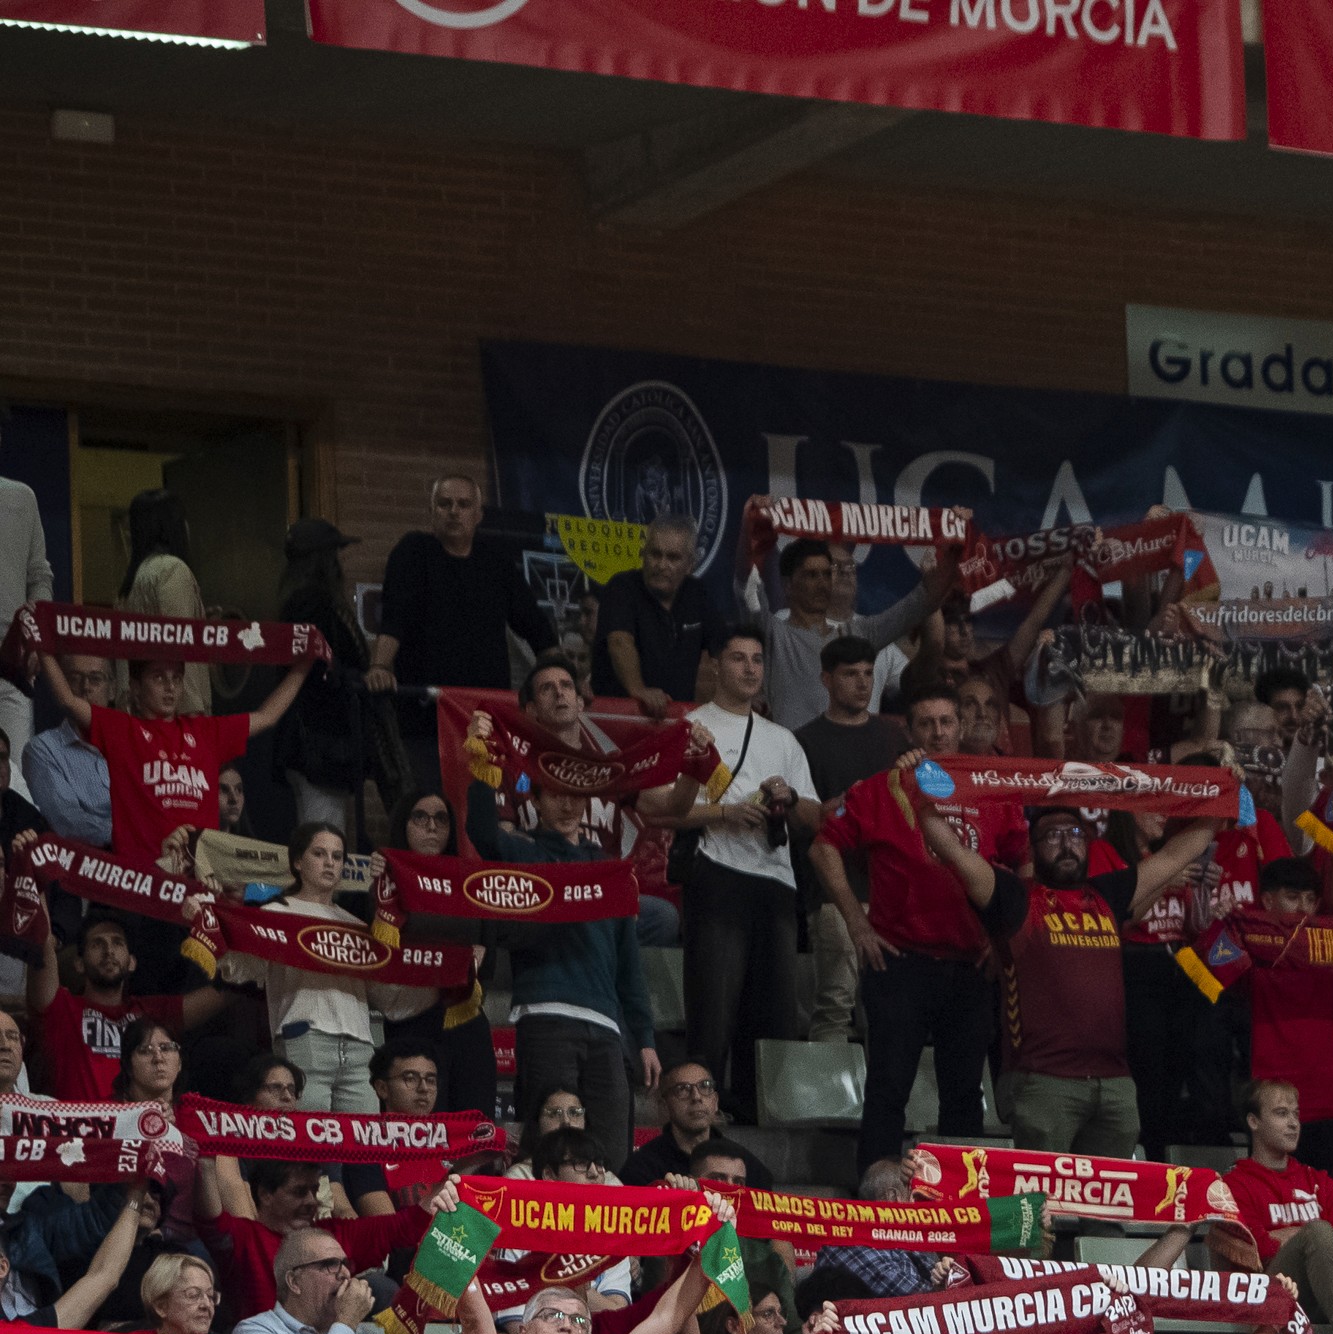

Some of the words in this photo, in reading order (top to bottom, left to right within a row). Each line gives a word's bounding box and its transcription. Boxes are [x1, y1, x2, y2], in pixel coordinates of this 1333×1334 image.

[948, 0, 1178, 51] MURCIA
[841, 503, 932, 543] MURCIA
[56, 614, 111, 640] UCAM
[120, 619, 194, 645] MURCIA
[202, 625, 229, 648] CB
[79, 854, 154, 897] MURCIA
[157, 880, 187, 905] CB
[416, 875, 453, 897] 1985
[481, 876, 534, 894] UCAM
[563, 884, 604, 902] 2023
[475, 888, 543, 912] MURCIA
[1044, 914, 1116, 934] UCAM
[199, 1110, 296, 1141] VAMOS
[306, 1117, 344, 1145] CB
[353, 1120, 448, 1149] MURCIA
[1054, 1156, 1094, 1178] CB
[1013, 1174, 1135, 1206] MURCIA
[510, 1197, 575, 1232] UCAM
[582, 1202, 670, 1235] MURCIA
[680, 1206, 711, 1235] CB
[750, 1190, 816, 1218] VAMOS
[818, 1198, 874, 1222] UCAM
[876, 1205, 952, 1226] MURCIA
[955, 1207, 982, 1226] CB
[1270, 1201, 1321, 1225] PUMA
[771, 1219, 804, 1234] COPA
[806, 1221, 830, 1237] DEL
[832, 1223, 854, 1238] REY
[871, 1227, 924, 1243] GRANADA
[927, 1230, 956, 1244] 2022
[1071, 1281, 1111, 1319] CB
